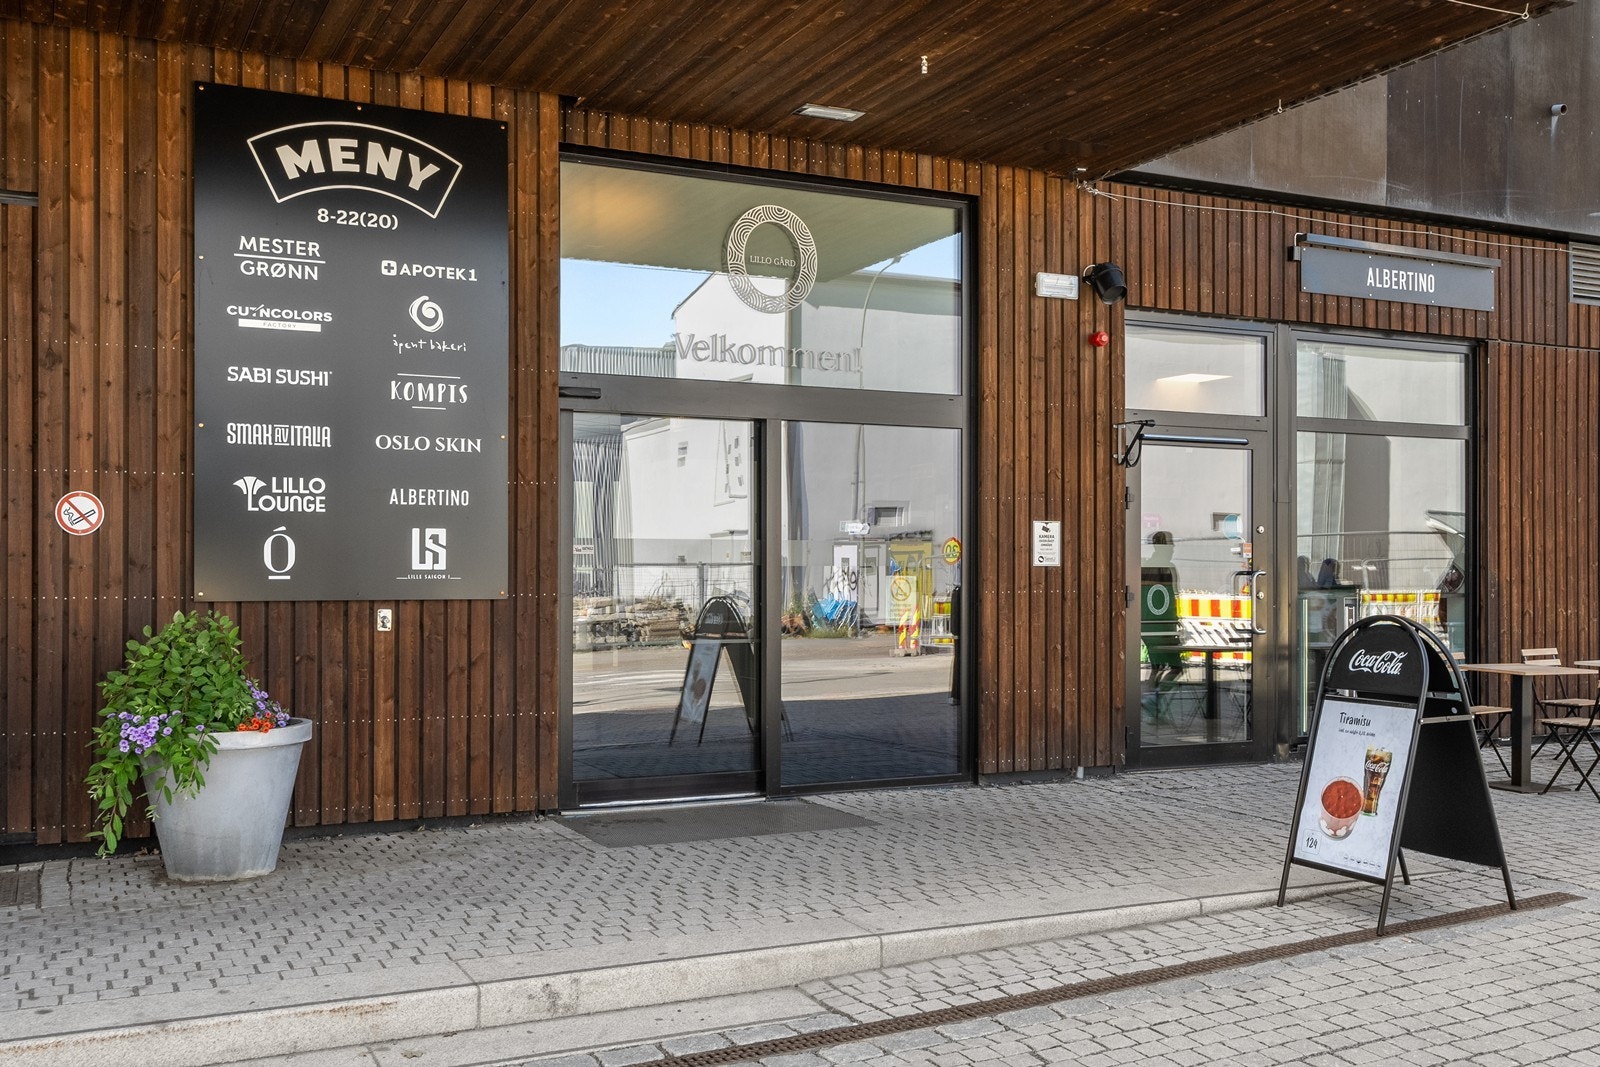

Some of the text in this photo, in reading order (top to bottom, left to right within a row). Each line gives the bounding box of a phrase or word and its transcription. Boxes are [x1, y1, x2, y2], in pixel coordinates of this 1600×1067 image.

[275, 138, 440, 190] MENY
[318, 209, 398, 230] 8-22(20)
[239, 236, 321, 257] MESTER
[240, 261, 319, 281] GRØNN
[750, 255, 796, 267] LILLO GÅRD
[400, 264, 477, 281] APOTEK 1
[1366, 267, 1435, 293] ALBERTINO
[262, 321, 298, 329] FACTORY
[430, 340, 466, 351] bakeri
[674, 332, 863, 373] Velkommen!
[228, 366, 331, 386] SABI SUSHI
[391, 380, 467, 404] KOMPIS
[226, 422, 273, 446] SMAK
[275, 426, 289, 443] AV
[376, 435, 481, 452] OSLO SKIN
[271, 476, 326, 494] LILLO
[247, 495, 326, 512] LOUNGE
[390, 489, 469, 506] ALBERTINO
[1349, 649, 1409, 674] Coca-Cola
[1339, 711, 1372, 727] Tiramisu
